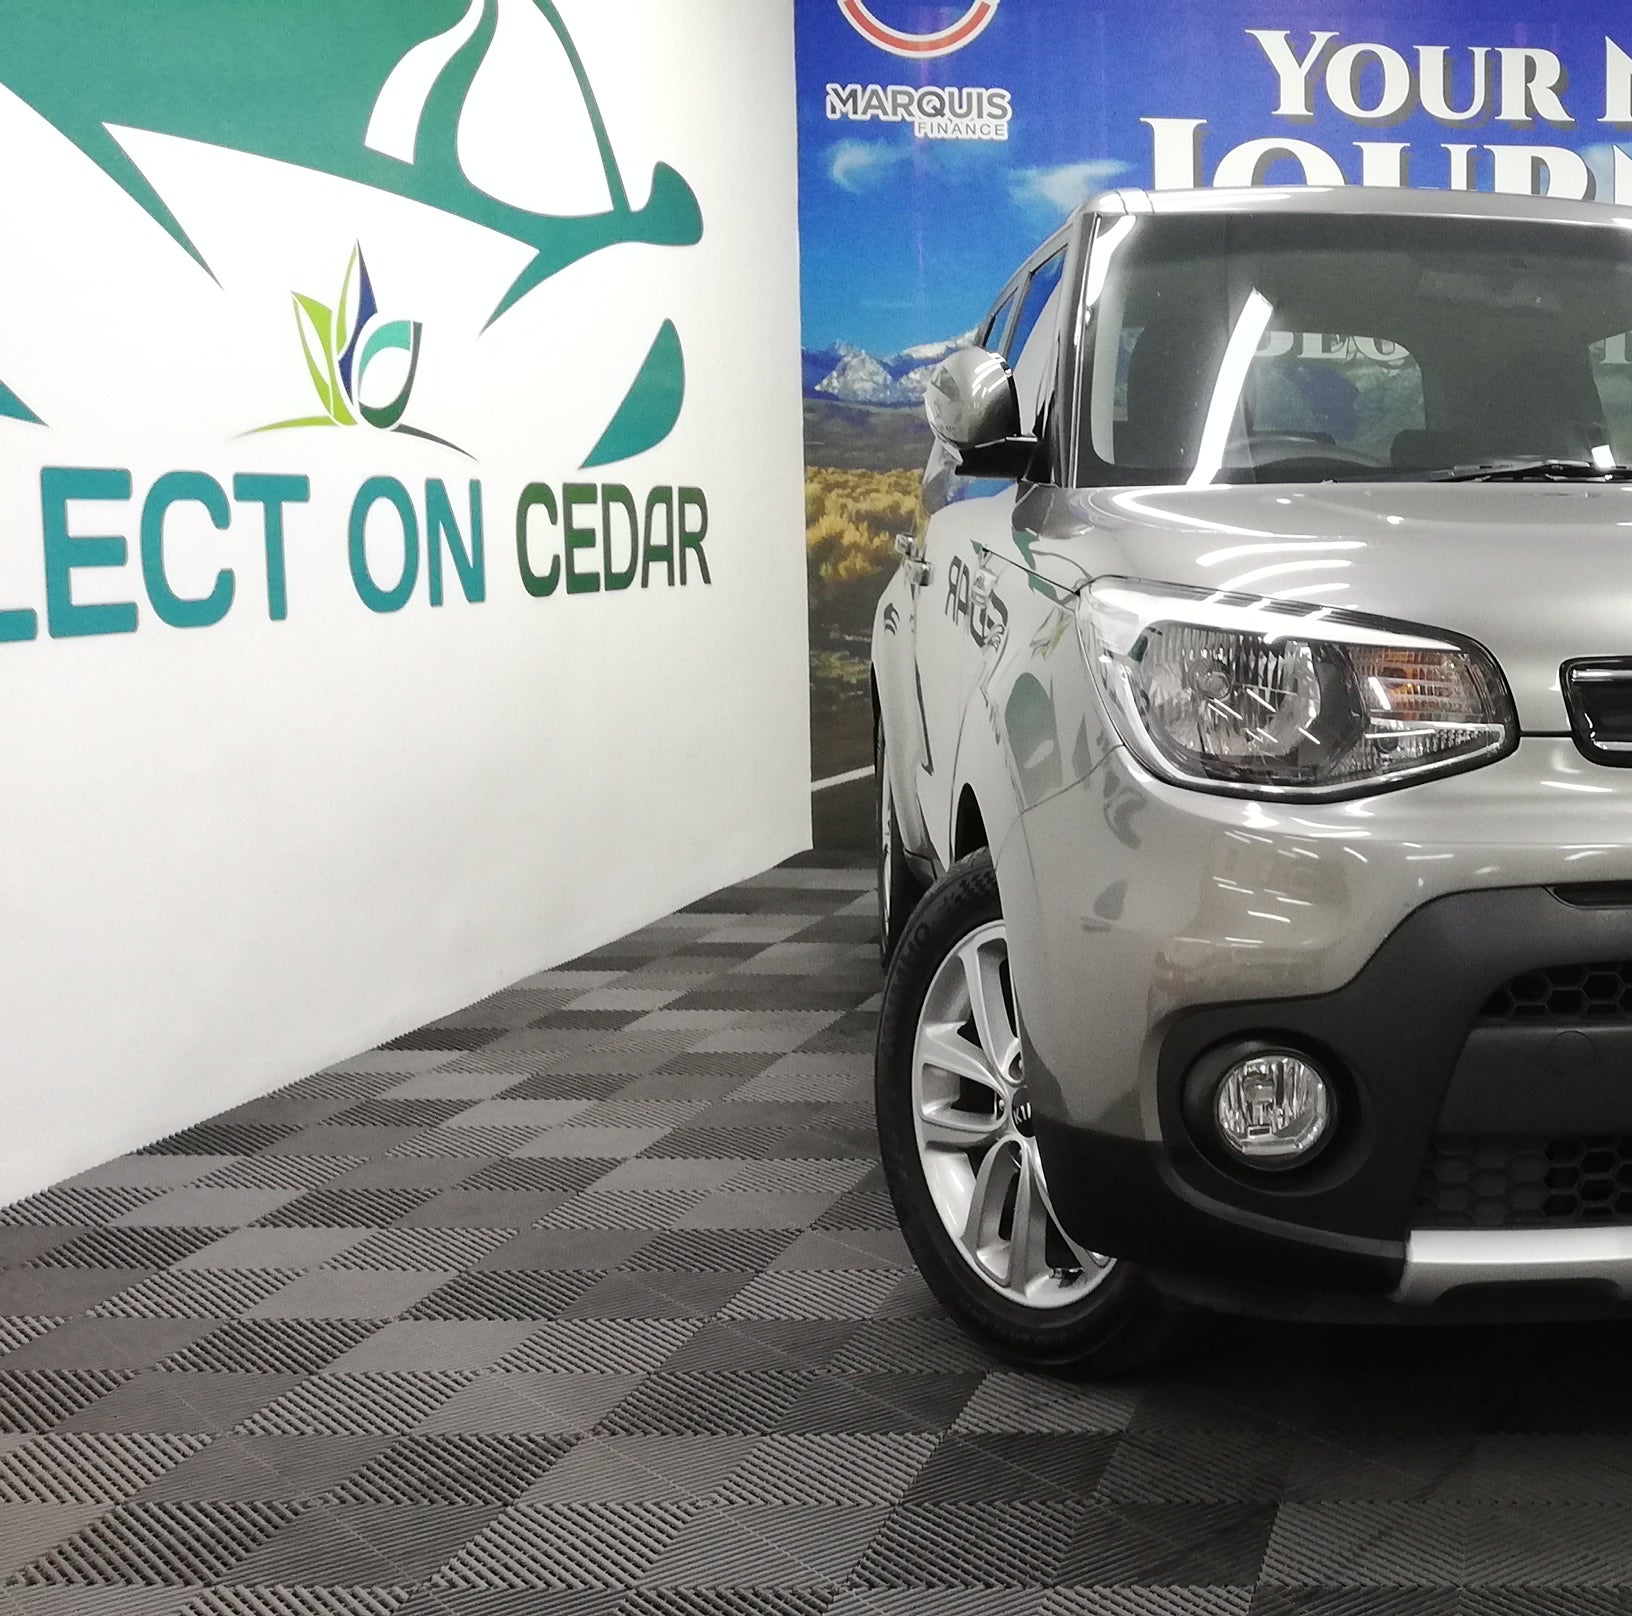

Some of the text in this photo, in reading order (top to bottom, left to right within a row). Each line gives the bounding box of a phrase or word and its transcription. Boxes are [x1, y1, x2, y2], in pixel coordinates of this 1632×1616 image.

[828, 85, 1010, 121] MARQUIS
[1245, 29, 1573, 124] YOUR
[916, 121, 1006, 137] FINANCE
[0, 467, 712, 642] ECT ON CEDAR
